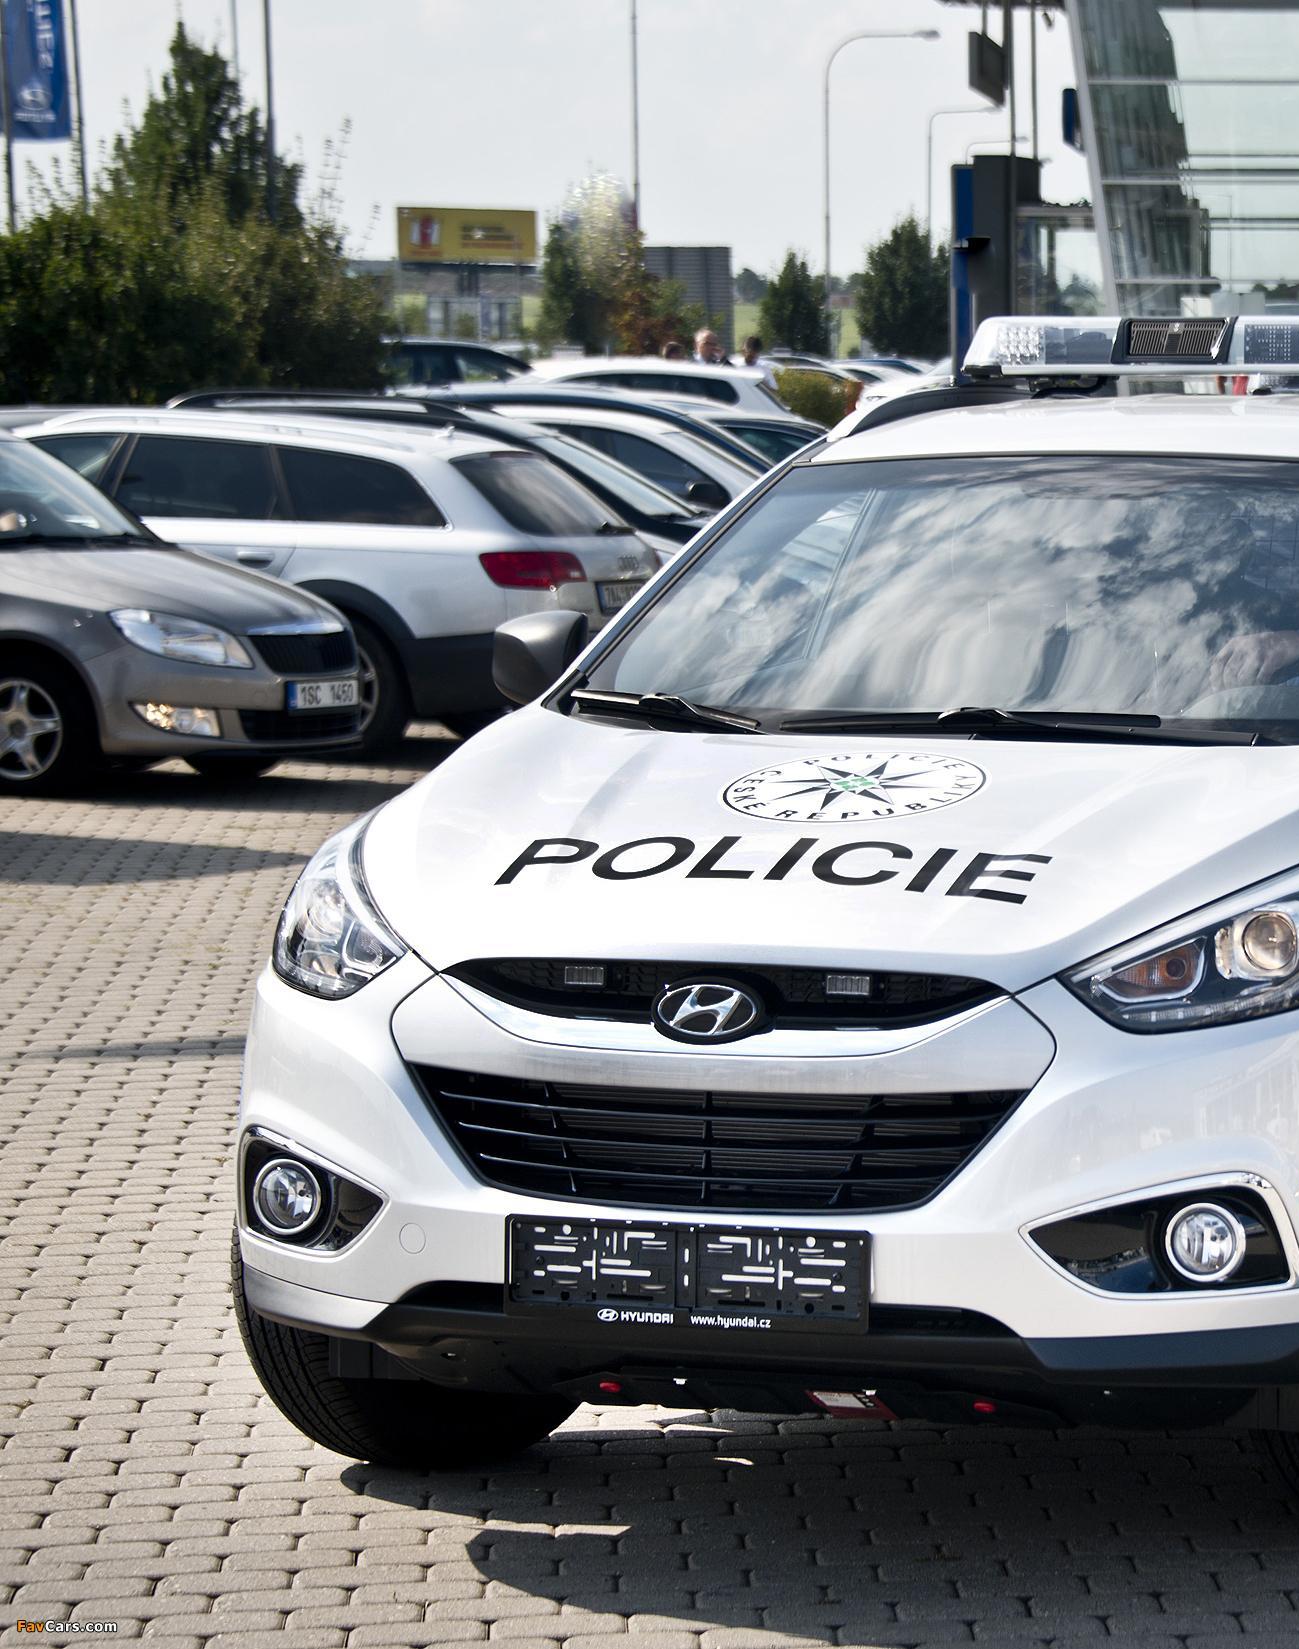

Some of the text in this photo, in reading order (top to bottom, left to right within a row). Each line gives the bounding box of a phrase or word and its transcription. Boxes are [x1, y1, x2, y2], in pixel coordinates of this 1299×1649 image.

[301, 685, 321, 705] 1SC
[803, 753, 965, 770] POLICIE
[774, 774, 976, 821] REPUBLIKY
[493, 836, 1053, 905] POLICIE
[620, 1311, 772, 1329] HYUNDAI www.hyundai.cz
